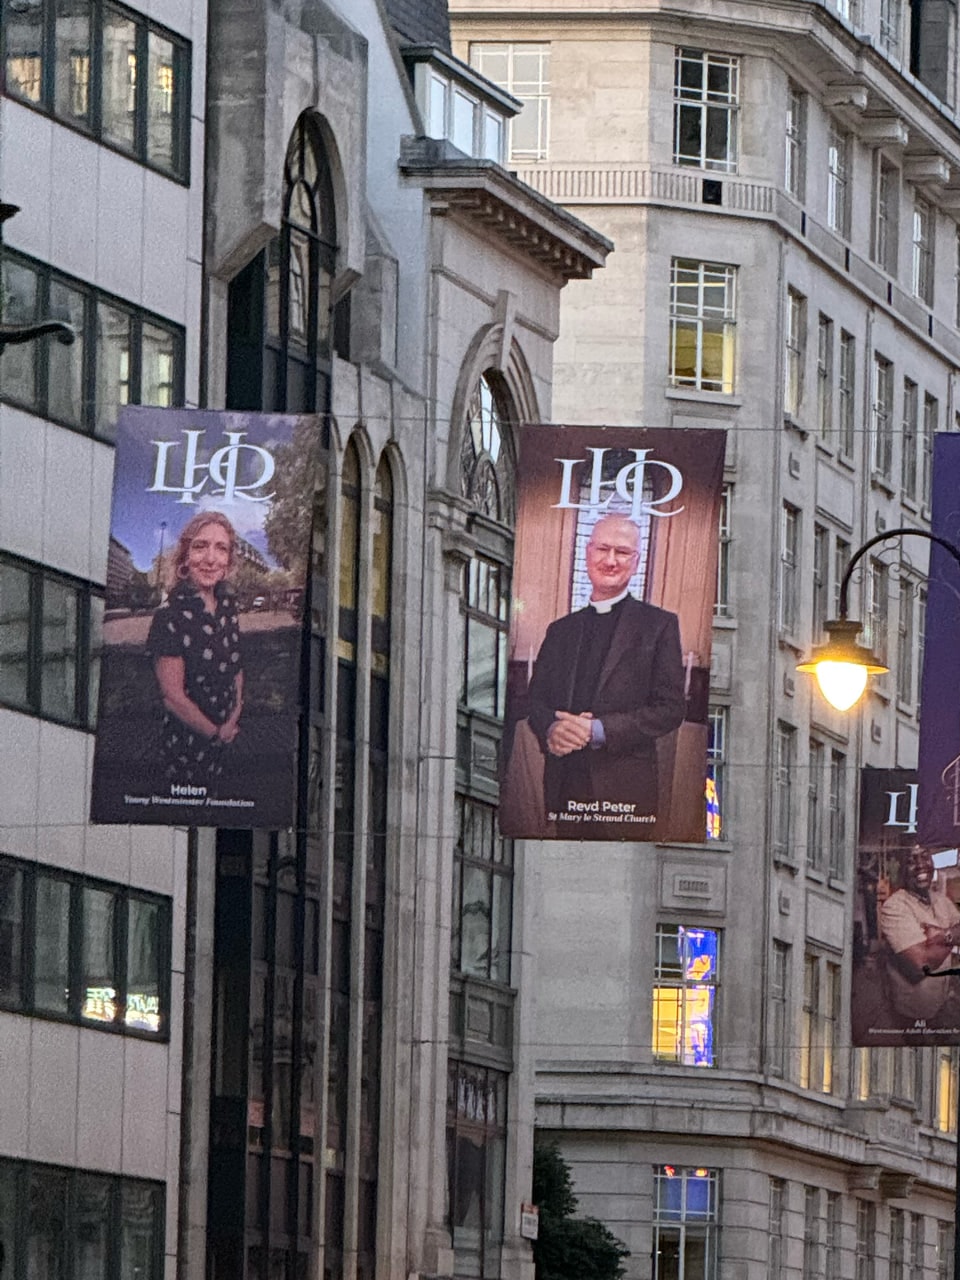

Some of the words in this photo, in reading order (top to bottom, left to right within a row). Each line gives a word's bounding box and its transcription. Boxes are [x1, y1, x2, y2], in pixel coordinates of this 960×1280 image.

[171, 784, 207, 796] Helen
[568, 800, 599, 812] Revd
[602, 801, 636, 813] Peter
[548, 812, 557, 821] St
[560, 813, 582, 823] Mary
[584, 813, 592, 821] le
[592, 813, 623, 822] Strand
[624, 814, 656, 823] Church
[914, 1019, 926, 1028] Ali
